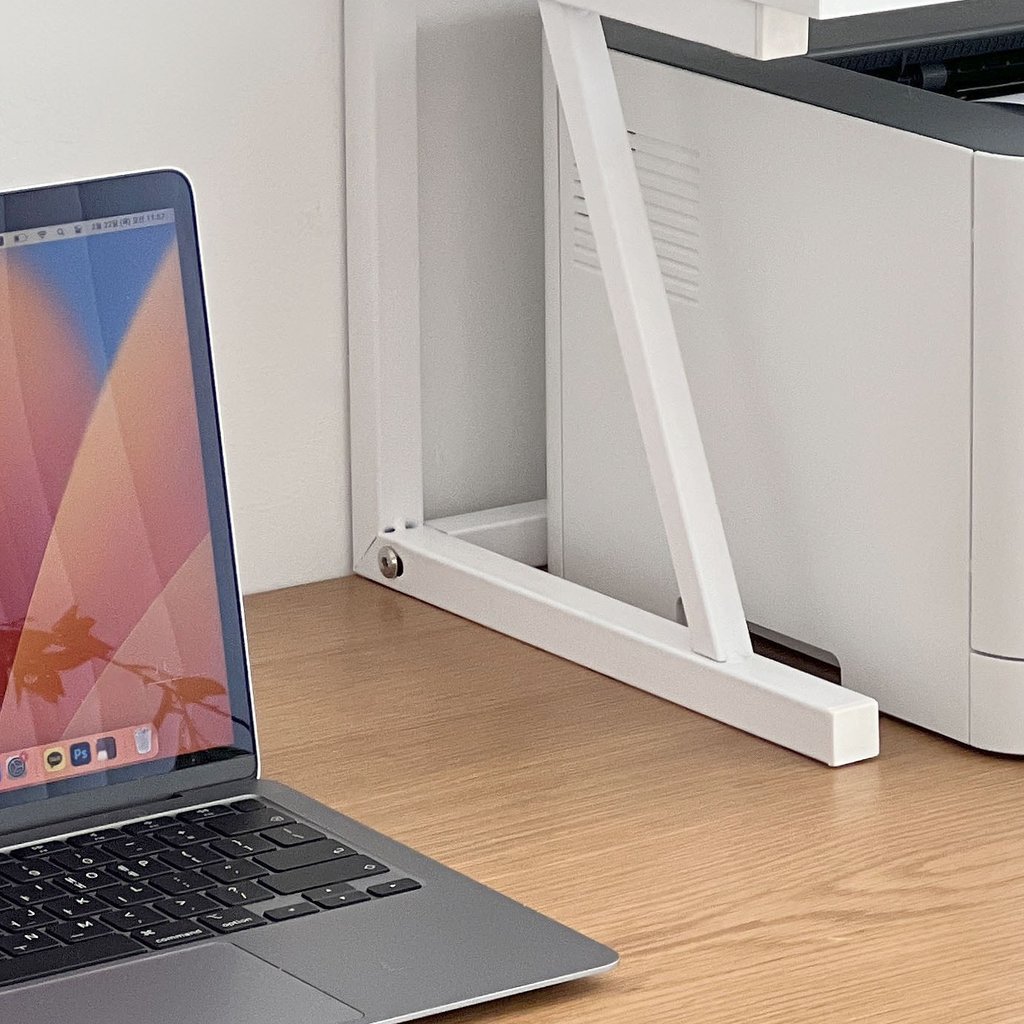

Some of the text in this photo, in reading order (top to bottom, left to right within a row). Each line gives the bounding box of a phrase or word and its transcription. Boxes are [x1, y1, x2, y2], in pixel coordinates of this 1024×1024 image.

[73, 748, 88, 760] Ps
[222, 917, 253, 928] option
[155, 928, 203, 944] command
